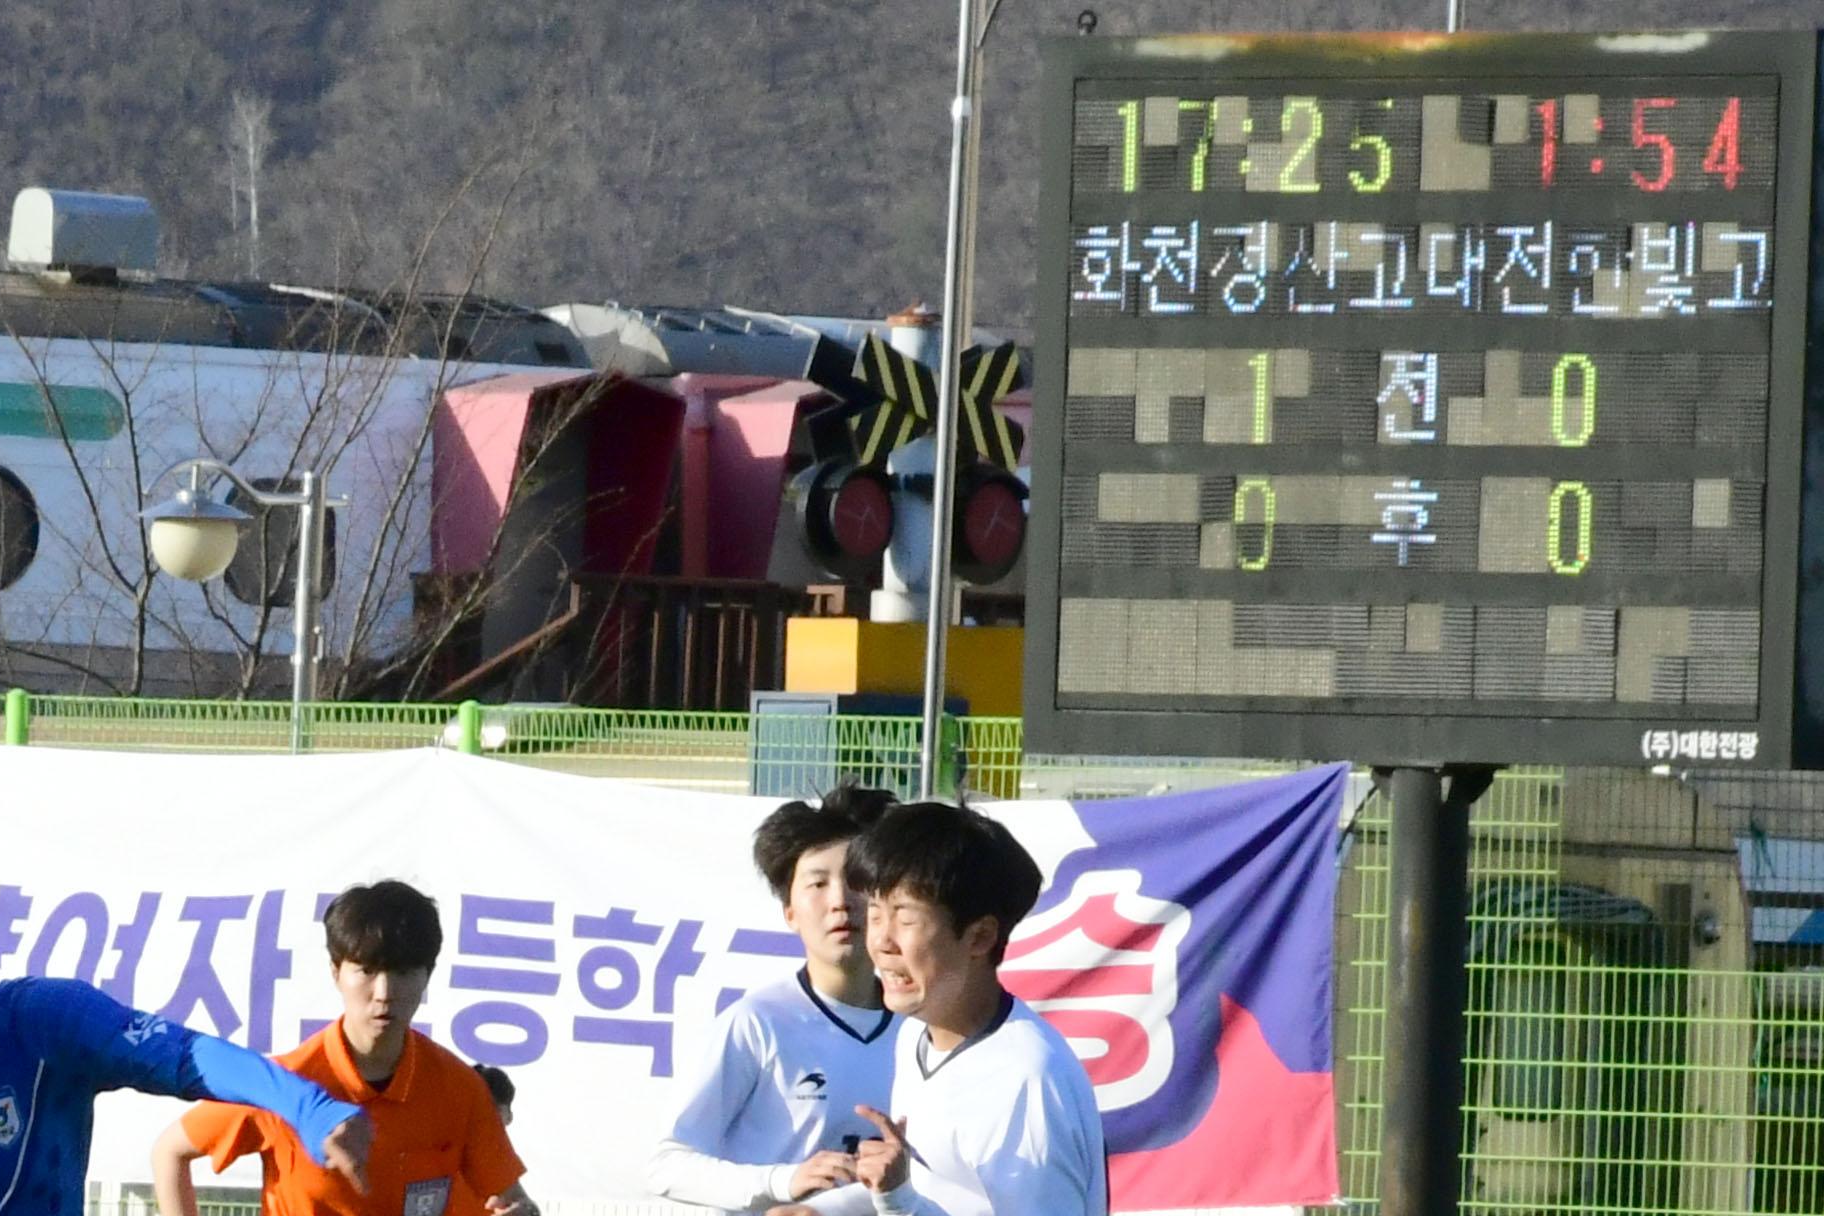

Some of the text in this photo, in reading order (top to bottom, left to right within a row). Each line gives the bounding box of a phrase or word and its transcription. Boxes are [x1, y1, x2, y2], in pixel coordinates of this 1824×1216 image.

[1117, 97, 1743, 192] 17:25 1:54
[1248, 352, 1597, 446] 1 전 0
[1234, 480, 1593, 575] 0 후 0
[1641, 730, 1759, 759] (주)대한전광
